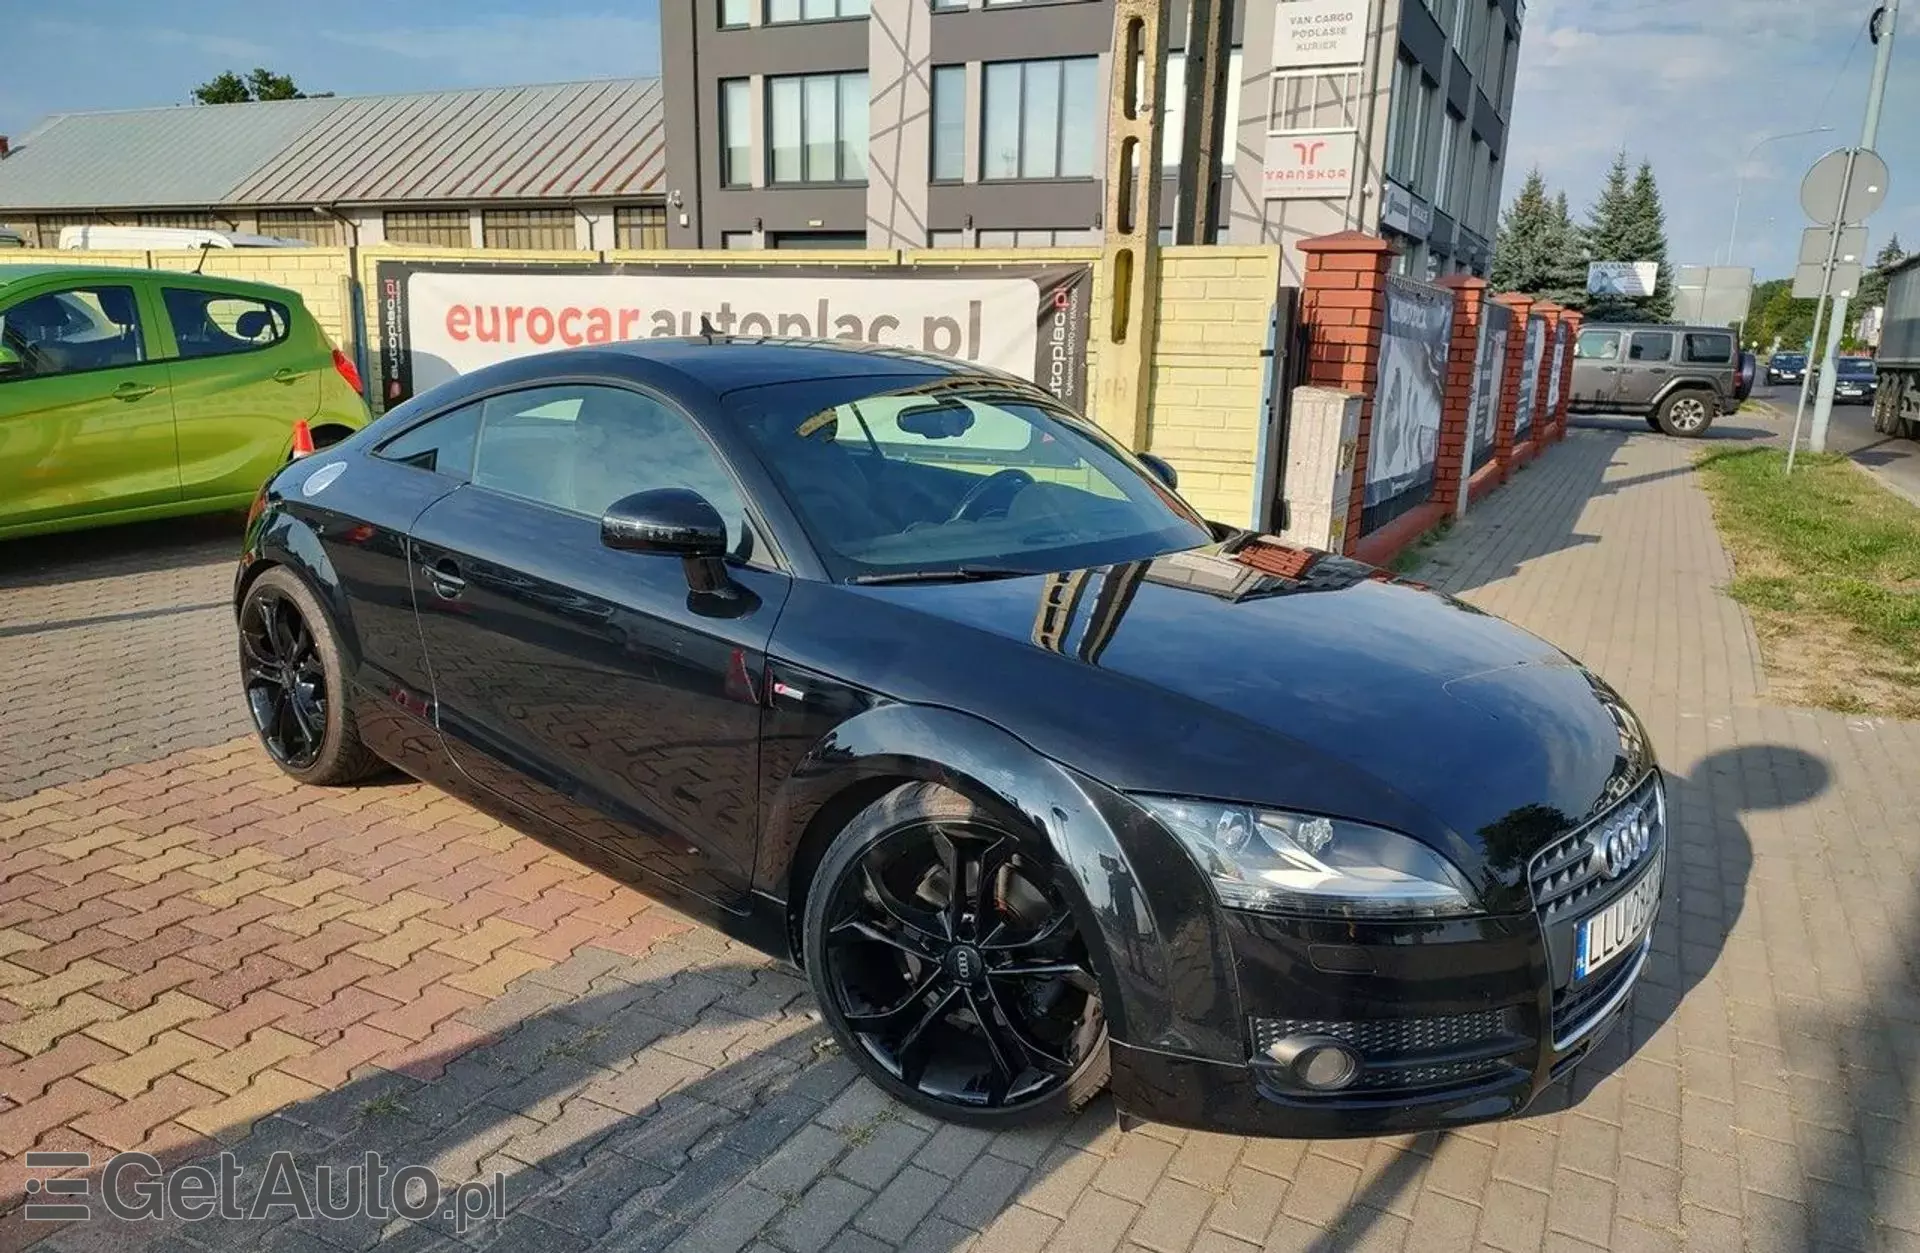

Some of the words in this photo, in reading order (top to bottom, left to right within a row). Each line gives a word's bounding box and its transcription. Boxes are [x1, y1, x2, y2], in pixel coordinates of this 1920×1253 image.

[1289, 16, 1312, 25] VAN
[1314, 12, 1353, 23] CARGO
[1291, 26, 1347, 38] PODLASIE
[1296, 40, 1338, 52] KURIER
[1049, 287, 1071, 399] utoplac.pl
[1590, 902, 1627, 967] LLU
